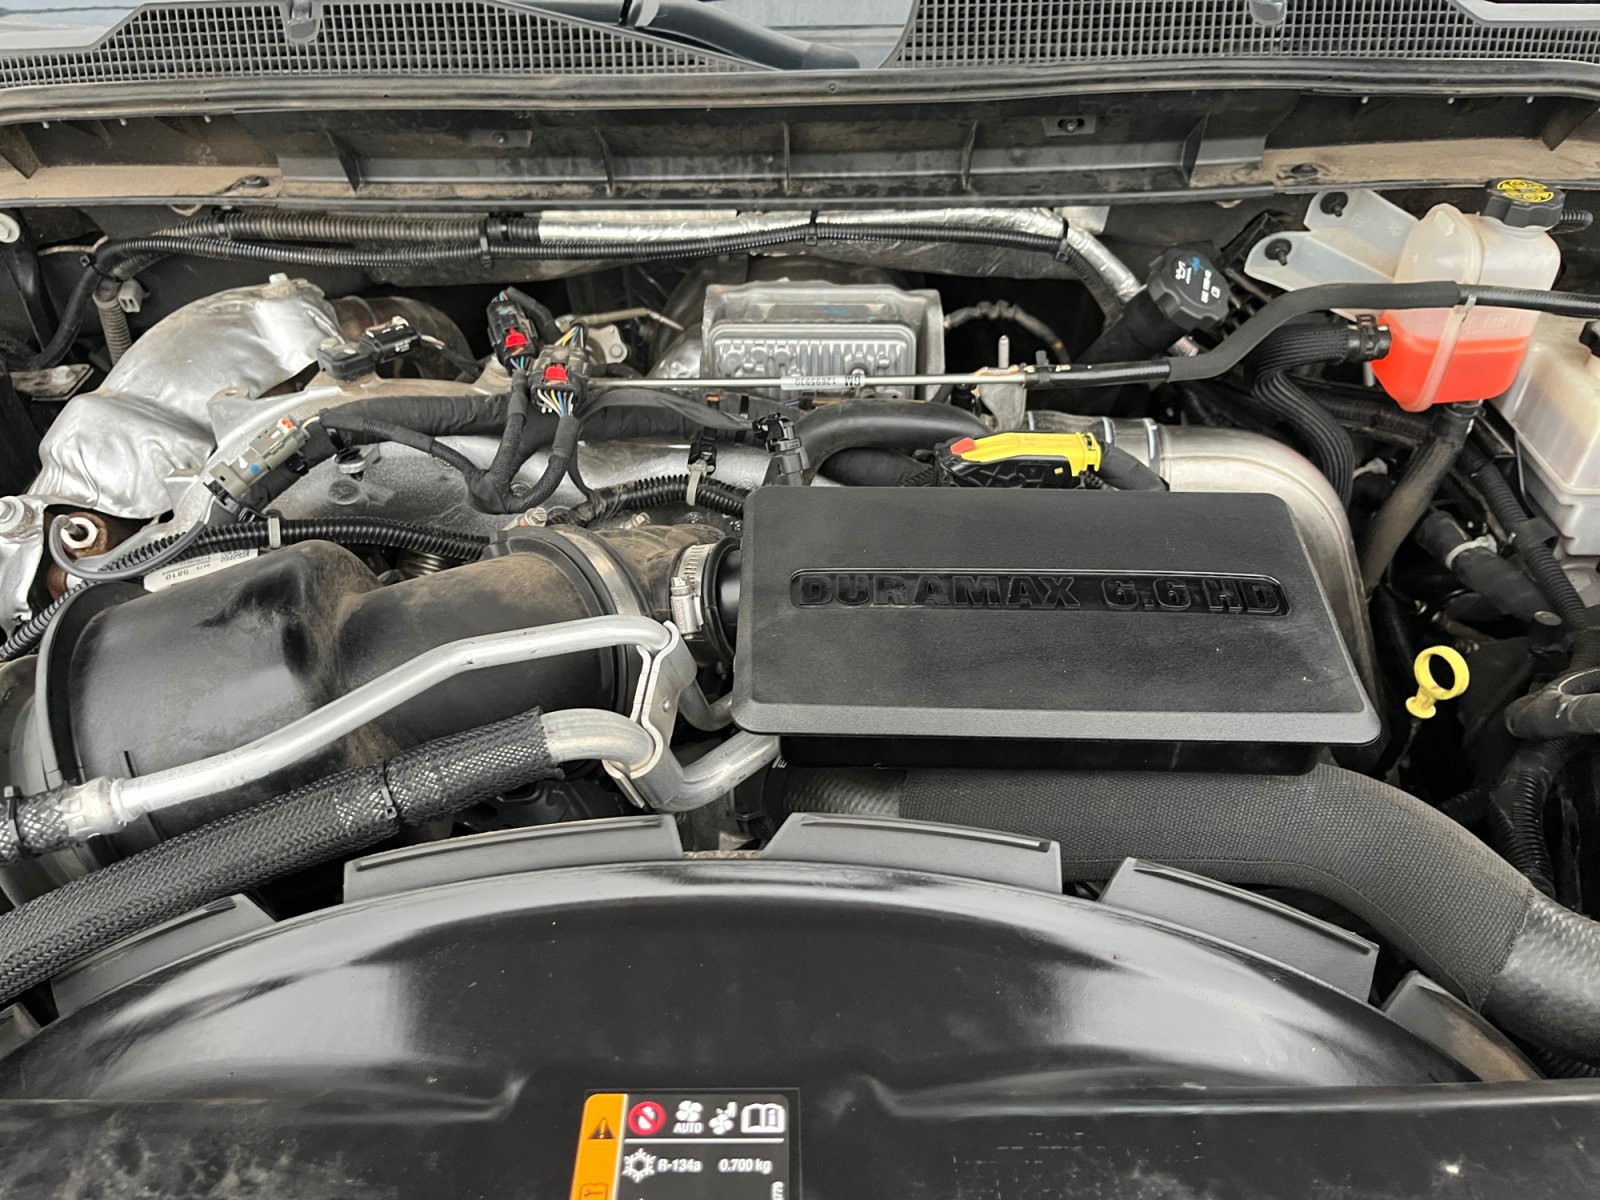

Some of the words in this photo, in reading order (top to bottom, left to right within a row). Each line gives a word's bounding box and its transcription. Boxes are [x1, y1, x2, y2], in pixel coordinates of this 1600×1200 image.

[844, 375, 861, 387] GM
[799, 574, 1081, 608] DURAMAX
[672, 1121, 704, 1134] AUTO
[656, 1158, 702, 1173] R-134a
[717, 1158, 753, 1172] 0.700
[754, 1158, 773, 1175] kg
